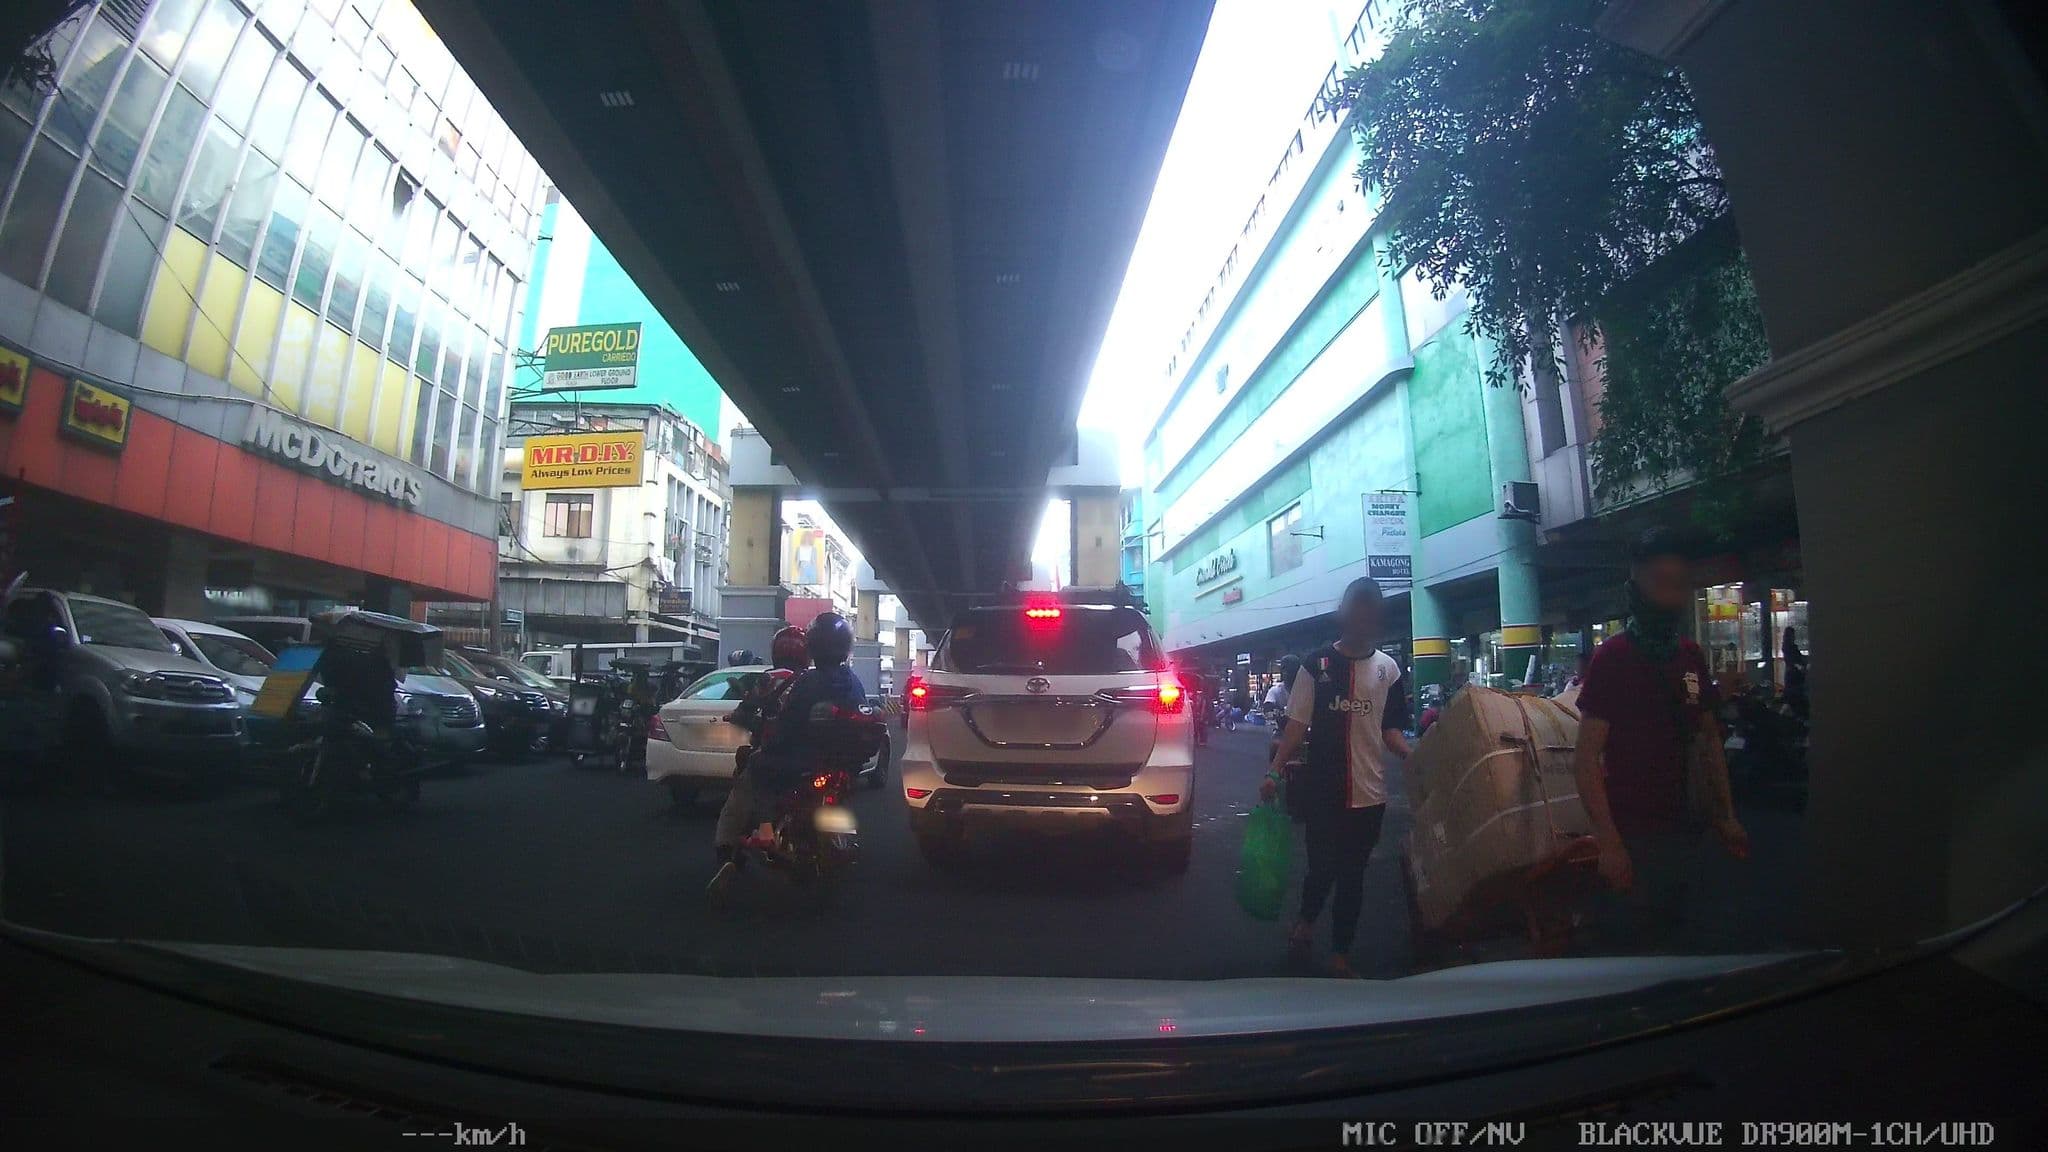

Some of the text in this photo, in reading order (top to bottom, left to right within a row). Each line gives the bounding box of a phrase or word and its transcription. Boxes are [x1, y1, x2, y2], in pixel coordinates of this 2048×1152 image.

[548, 329, 638, 355] PUREGOLD
[602, 352, 636, 363] CARRIEDO
[589, 370, 607, 378] LOWER
[608, 368, 631, 376] GROUND
[601, 377, 619, 385] FLOOR
[241, 403, 424, 506] McDonald's
[530, 442, 636, 467] MR D.I.Y.
[531, 466, 631, 479] Always Low Prices
[1370, 558, 1410, 568] KAMAGONG
[1328, 695, 1373, 716] Jeep
